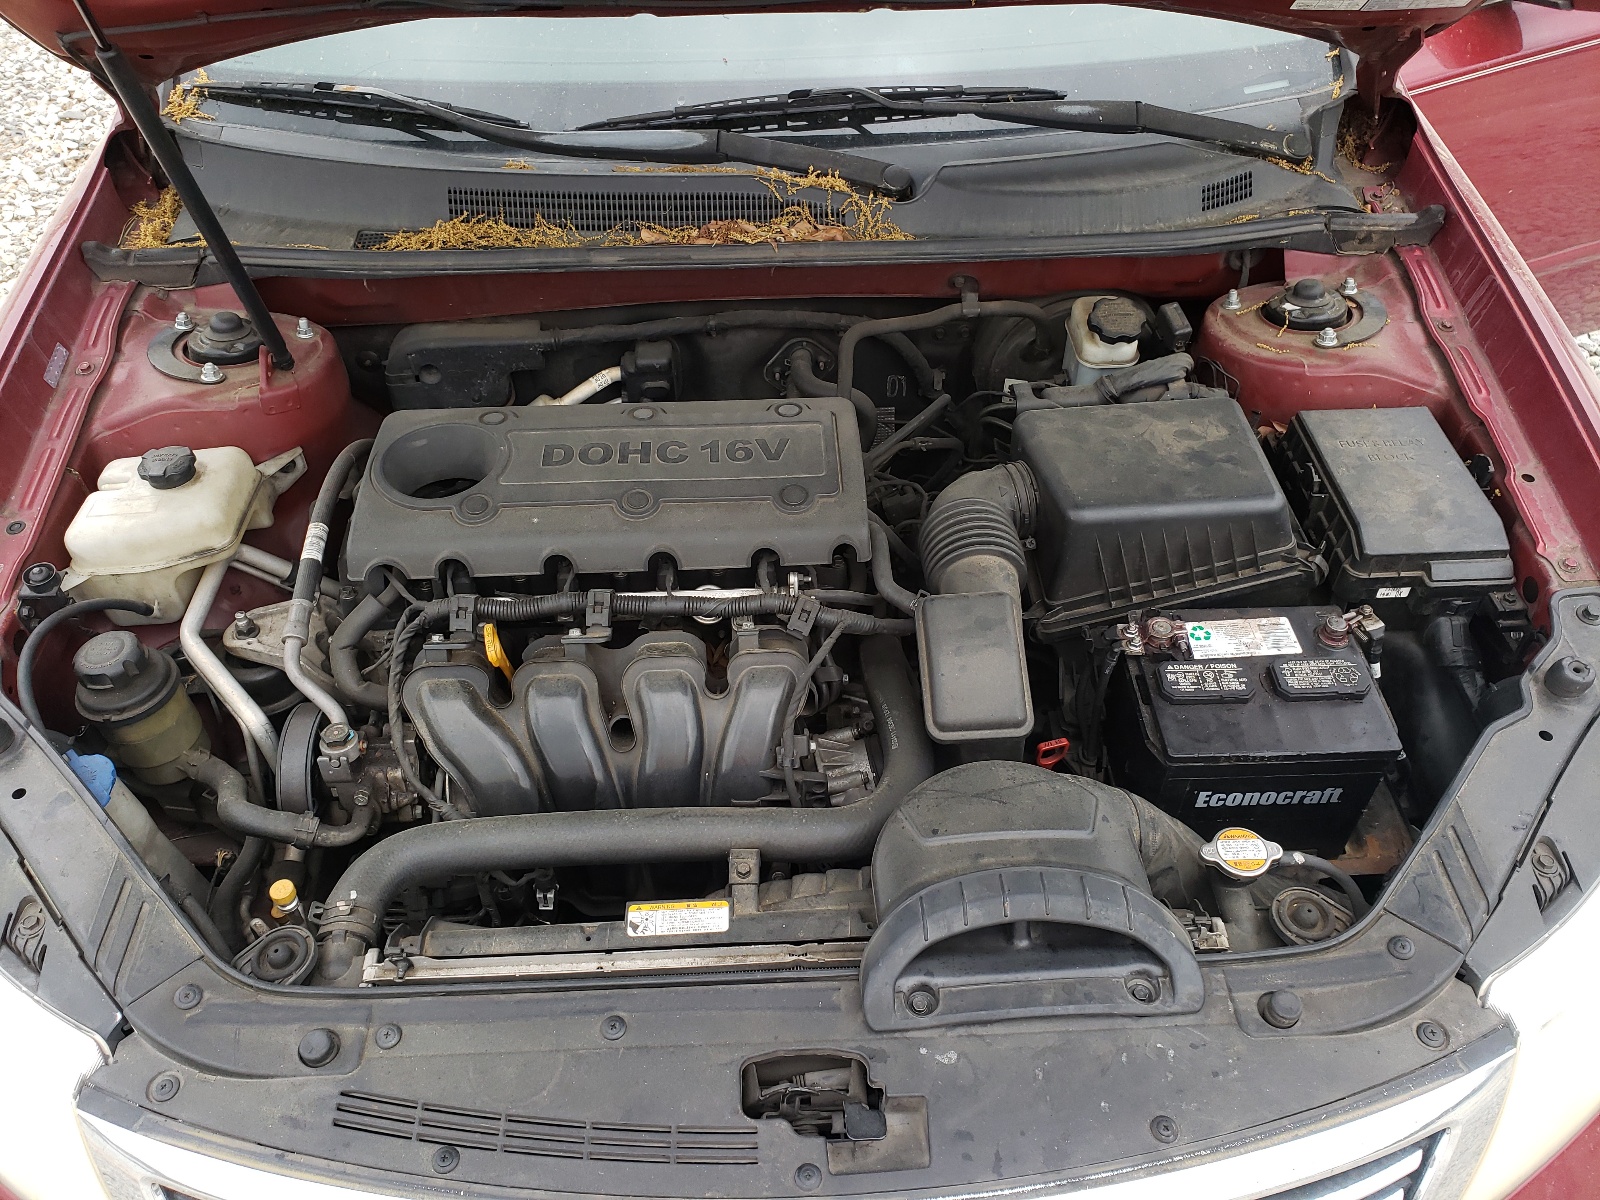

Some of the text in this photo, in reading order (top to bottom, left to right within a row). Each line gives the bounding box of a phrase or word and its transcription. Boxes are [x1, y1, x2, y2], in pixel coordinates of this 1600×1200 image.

[1338, 440, 1370, 448] FUSE
[1382, 438, 1425, 447] RELAY
[541, 438, 790, 467] DOHC 16V
[1367, 453, 1415, 461] BLOCK
[1194, 787, 1344, 808] Econocraft
